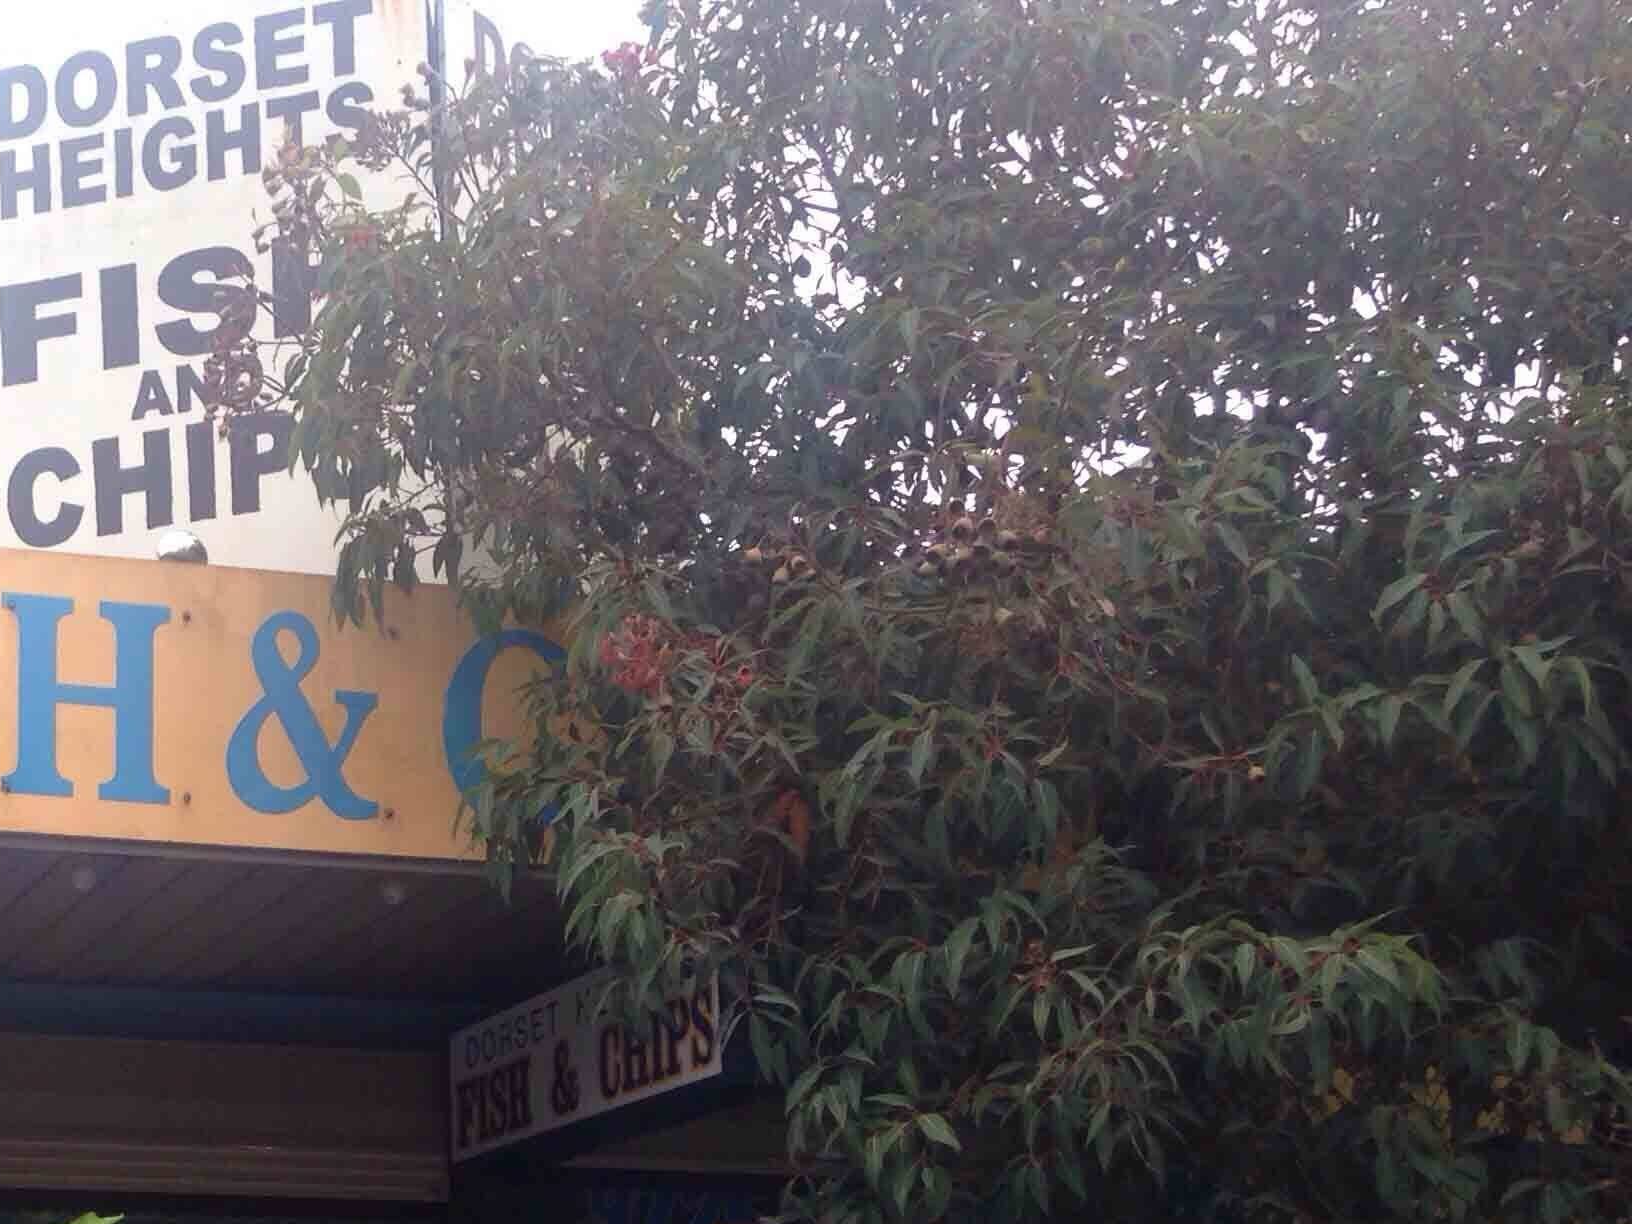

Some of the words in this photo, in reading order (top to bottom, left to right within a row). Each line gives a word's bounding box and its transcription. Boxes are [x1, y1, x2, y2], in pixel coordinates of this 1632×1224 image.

[0, 82, 375, 221] HEIGHTS
[6, 408, 293, 548] CHIP
[226, 610, 379, 821] &
[457, 1053, 532, 1148] FISH
[552, 1038, 579, 1115] &
[600, 988, 713, 1100] CHIPS
[466, 1000, 559, 1069] DORSET
